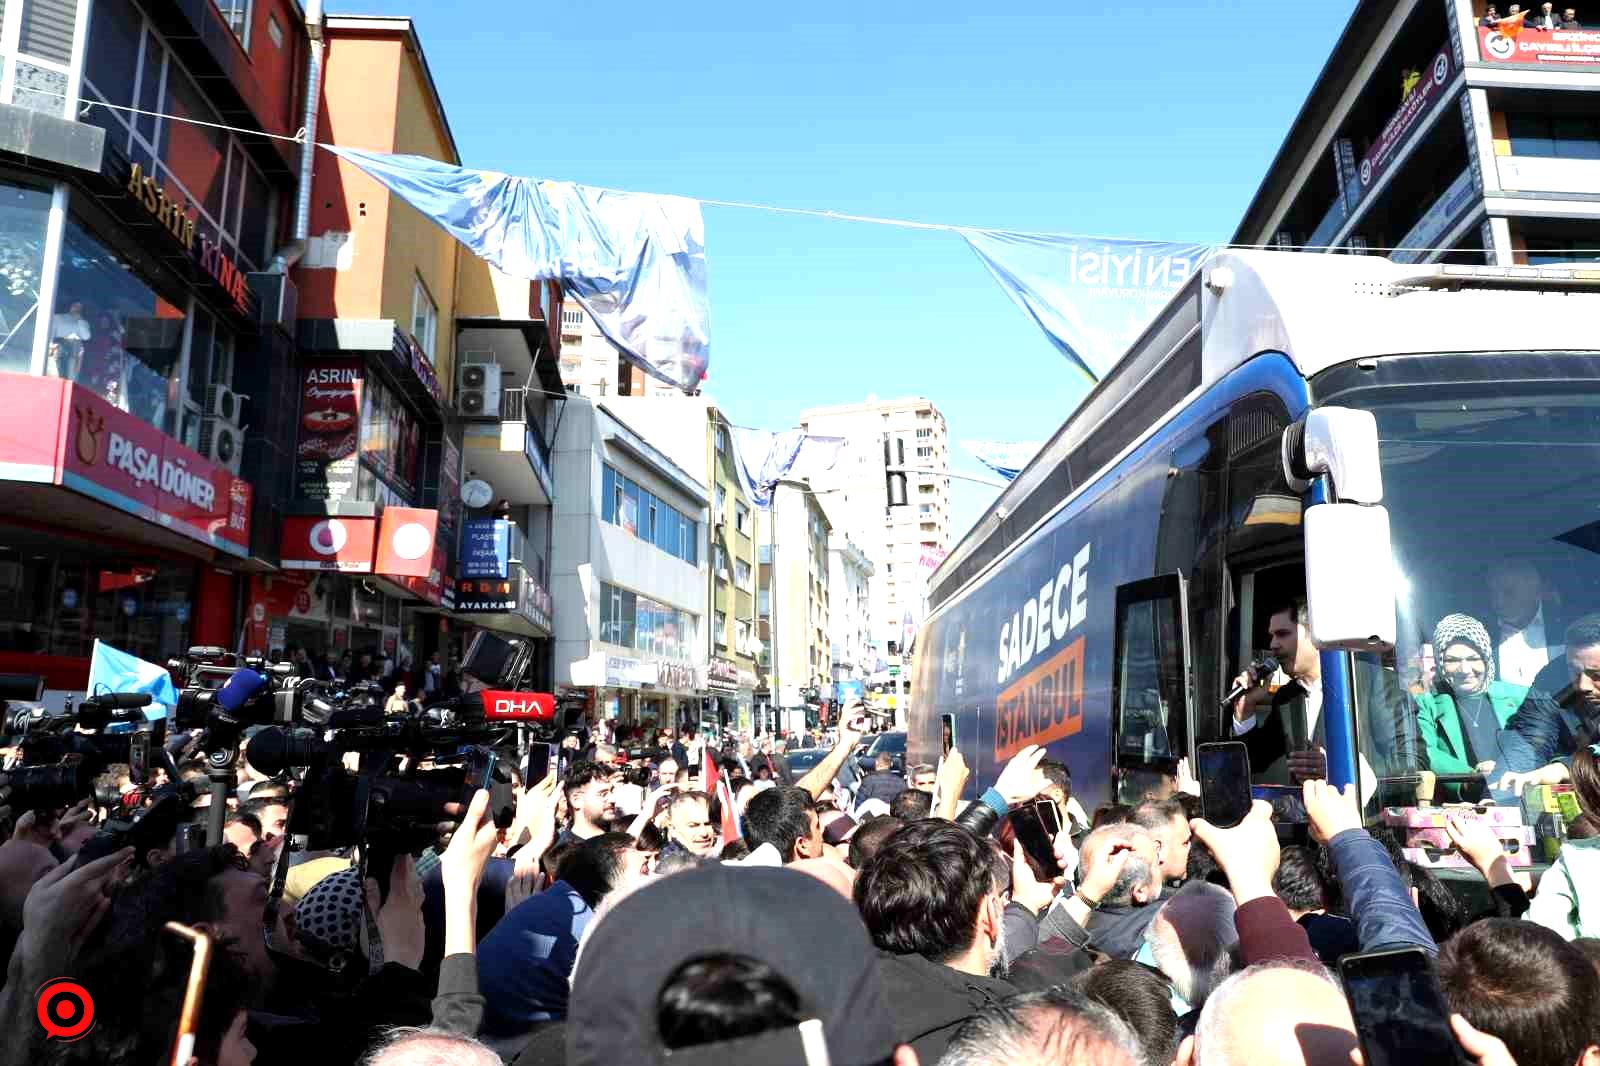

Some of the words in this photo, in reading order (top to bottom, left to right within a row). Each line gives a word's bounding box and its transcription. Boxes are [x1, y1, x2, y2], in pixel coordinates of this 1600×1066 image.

[306, 368, 358, 384] ASRIN
[107, 432, 160, 488] PAŞA
[160, 459, 216, 513] DÖNER
[997, 541, 1091, 684] SADECE
[495, 699, 543, 715] DHA
